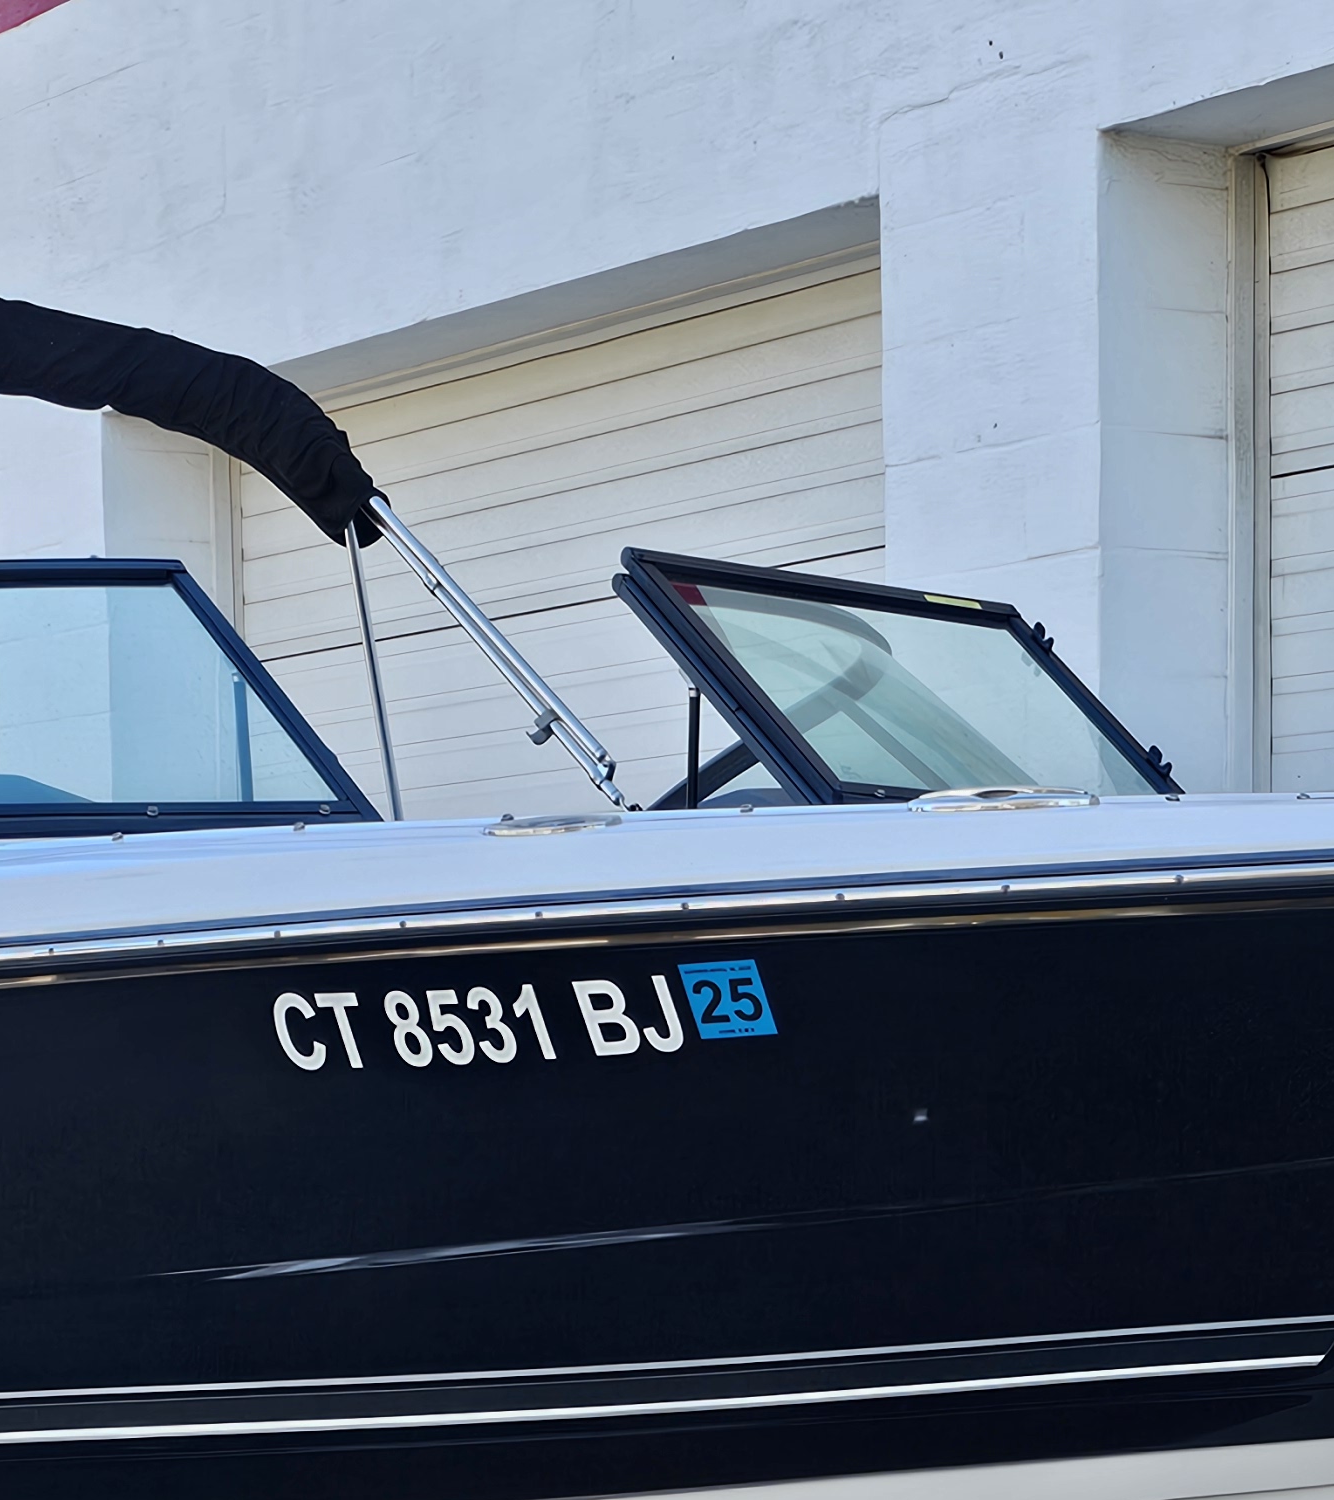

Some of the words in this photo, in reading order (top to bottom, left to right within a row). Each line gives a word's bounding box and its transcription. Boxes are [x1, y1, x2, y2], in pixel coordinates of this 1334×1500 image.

[273, 991, 364, 1071] CT
[383, 982, 558, 1068] 8531
[571, 974, 685, 1058] BJ
[692, 977, 764, 1025] 25
